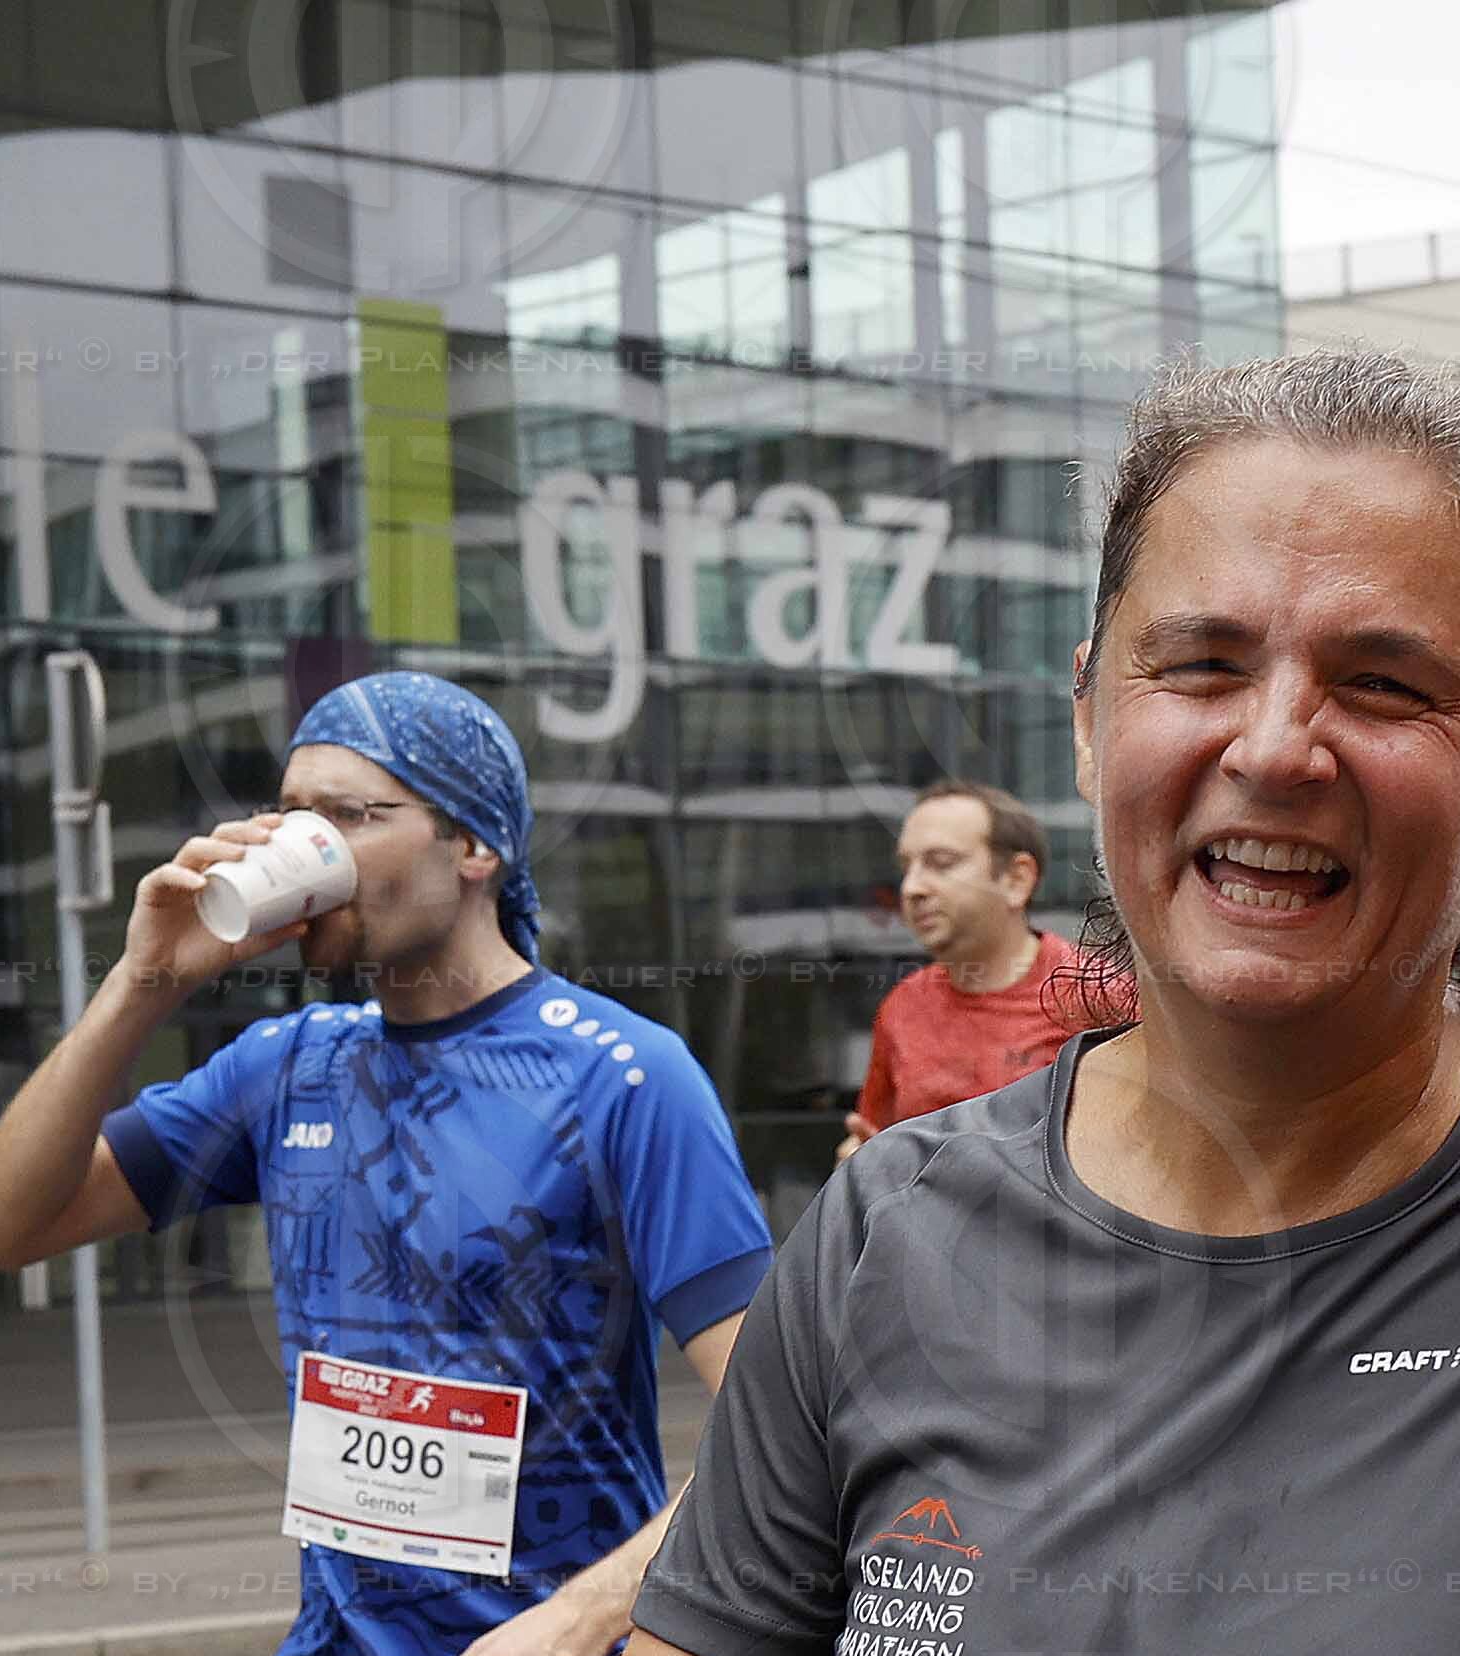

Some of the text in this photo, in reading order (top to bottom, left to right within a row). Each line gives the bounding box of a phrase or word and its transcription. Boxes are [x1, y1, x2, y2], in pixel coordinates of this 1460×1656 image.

[524, 470, 961, 742] graz
[283, 1121, 334, 1149] JAKO
[1349, 1350, 1451, 1374] CRAFT
[341, 1368, 392, 1397] GRAZ
[341, 1425, 445, 1479] 2096
[355, 1490, 416, 1518] Gernot
[860, 1554, 975, 1597] ICELAND
